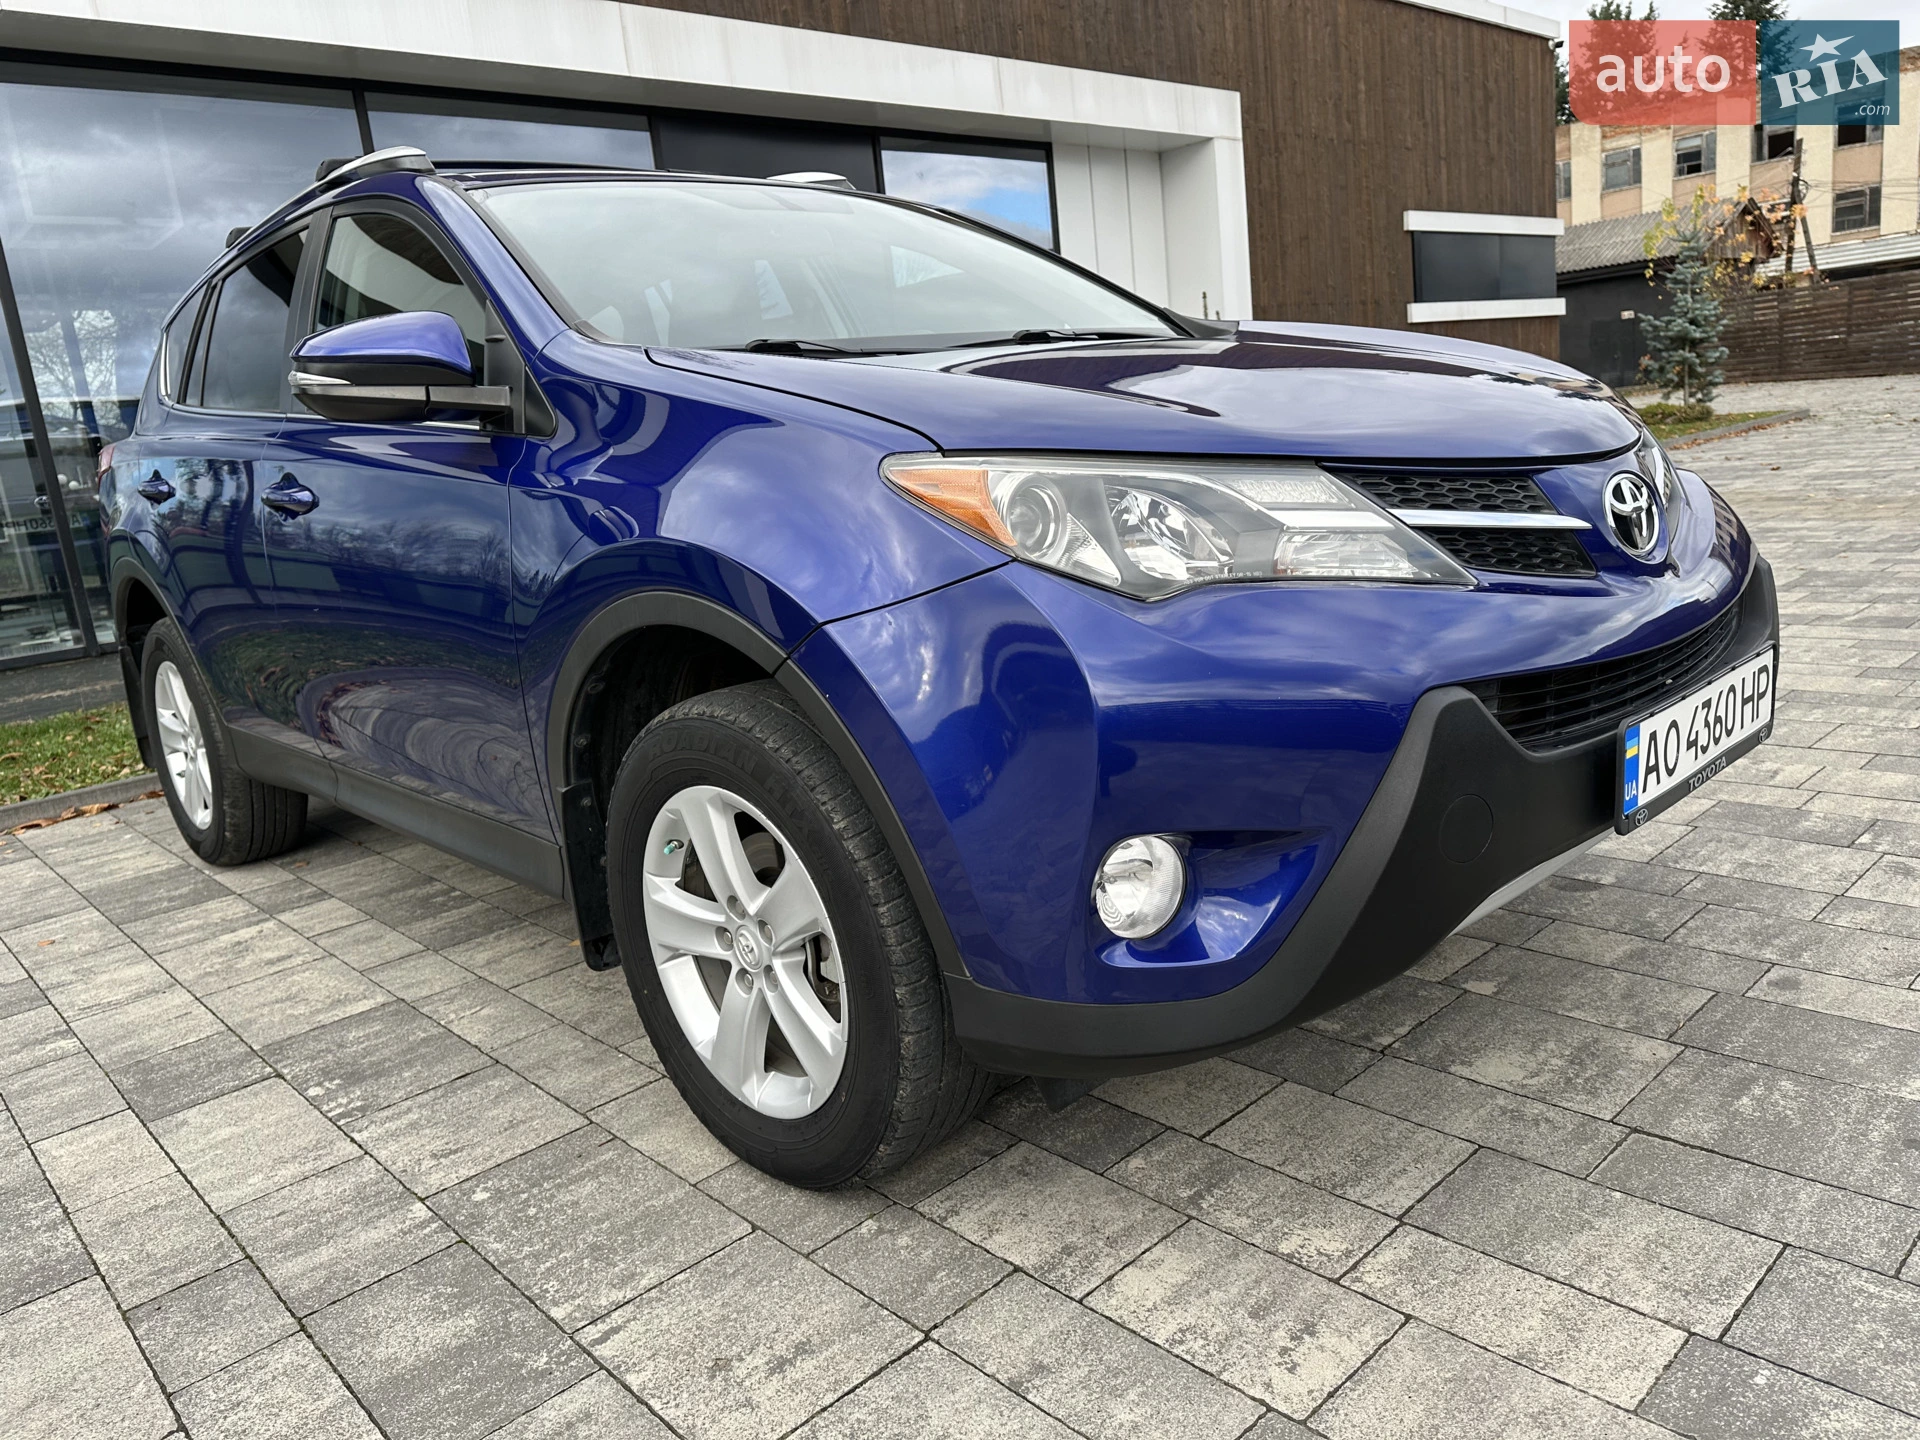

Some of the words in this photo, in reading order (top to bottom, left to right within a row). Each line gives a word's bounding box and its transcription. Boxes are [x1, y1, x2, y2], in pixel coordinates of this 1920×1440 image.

[1641, 719, 1681, 794] AO
[1685, 684, 1737, 762] 4360
[1740, 664, 1770, 731] HP
[648, 730, 759, 776] ROADIAN
[1624, 781, 1637, 800] UA
[1688, 756, 1728, 792] TOYOTA
